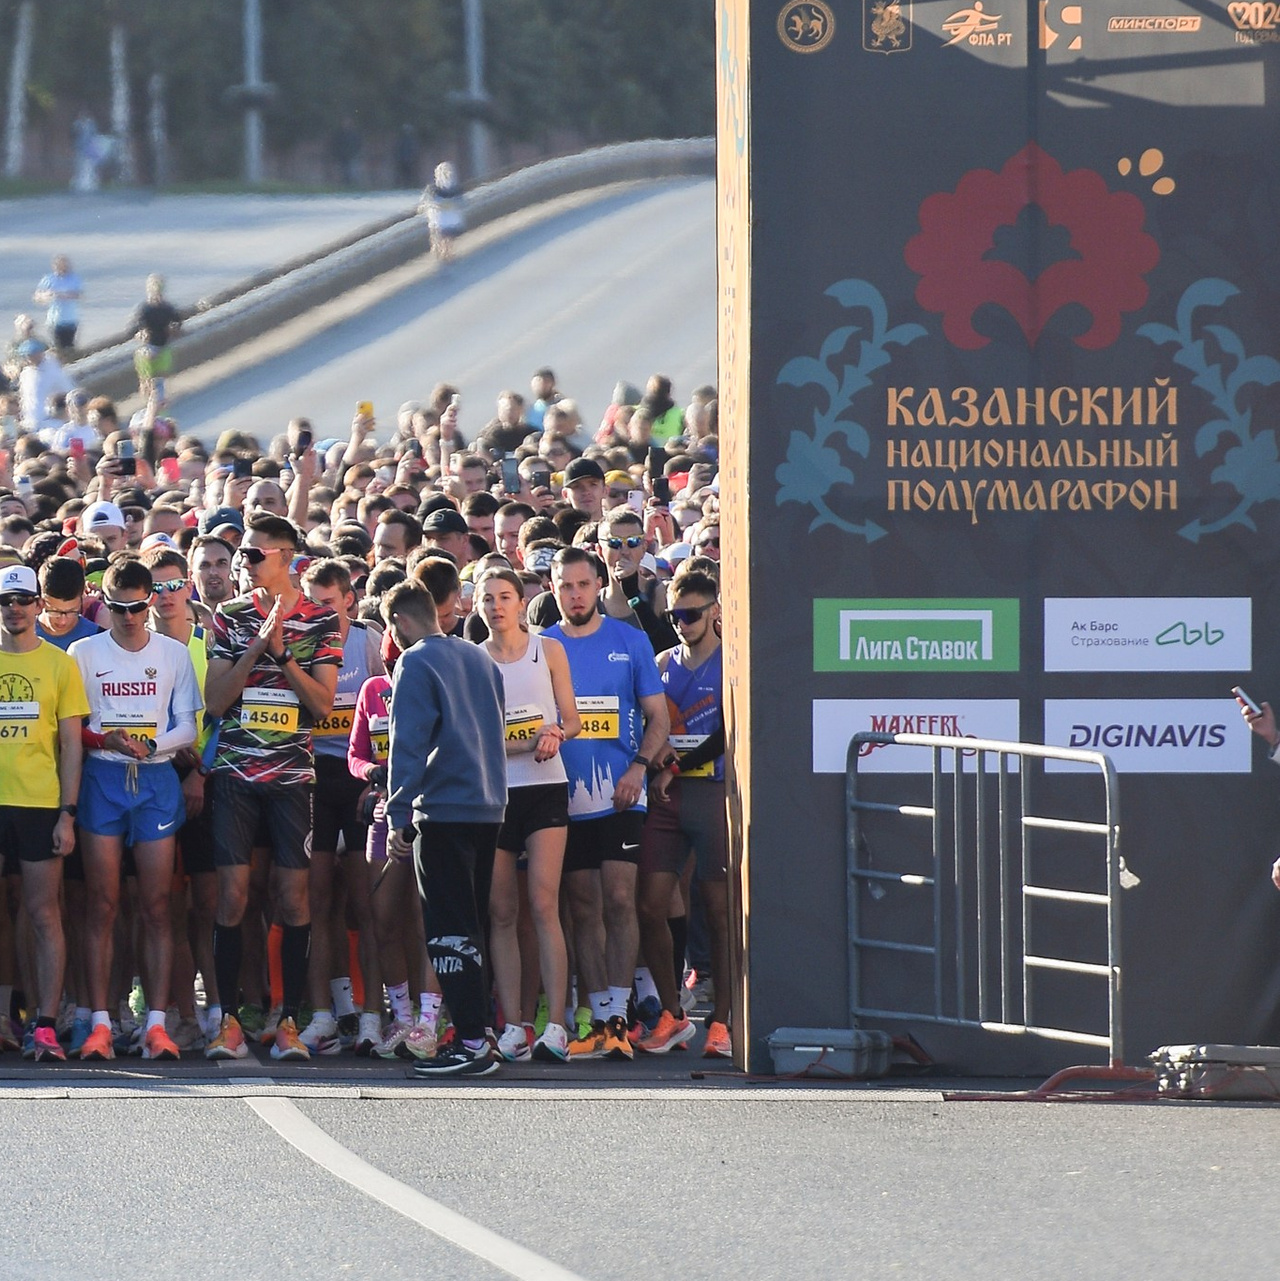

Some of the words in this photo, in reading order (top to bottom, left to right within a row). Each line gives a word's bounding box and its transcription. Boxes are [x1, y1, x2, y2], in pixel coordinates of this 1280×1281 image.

[1110, 18, 1198, 30] МИНСПОРТ
[968, 33, 995, 46] ФЛА
[997, 33, 1013, 46] РТ
[886, 376, 1178, 427] КАЗАНСКИЙ
[886, 432, 1179, 472] НАЦИОНАЛЬНЫЙ
[886, 478, 1179, 525] ПОЛУМАРАФОН
[1071, 621, 1087, 631] Ак
[1090, 621, 1119, 633] Барс
[1071, 635, 1150, 647] Страхование
[101, 682, 157, 696] RUSSIA
[250, 711, 289, 725] 4540
[581, 720, 611, 732] 484
[505, 727, 537, 741] 685
[1069, 724, 1226, 748] DIGINAVIS
